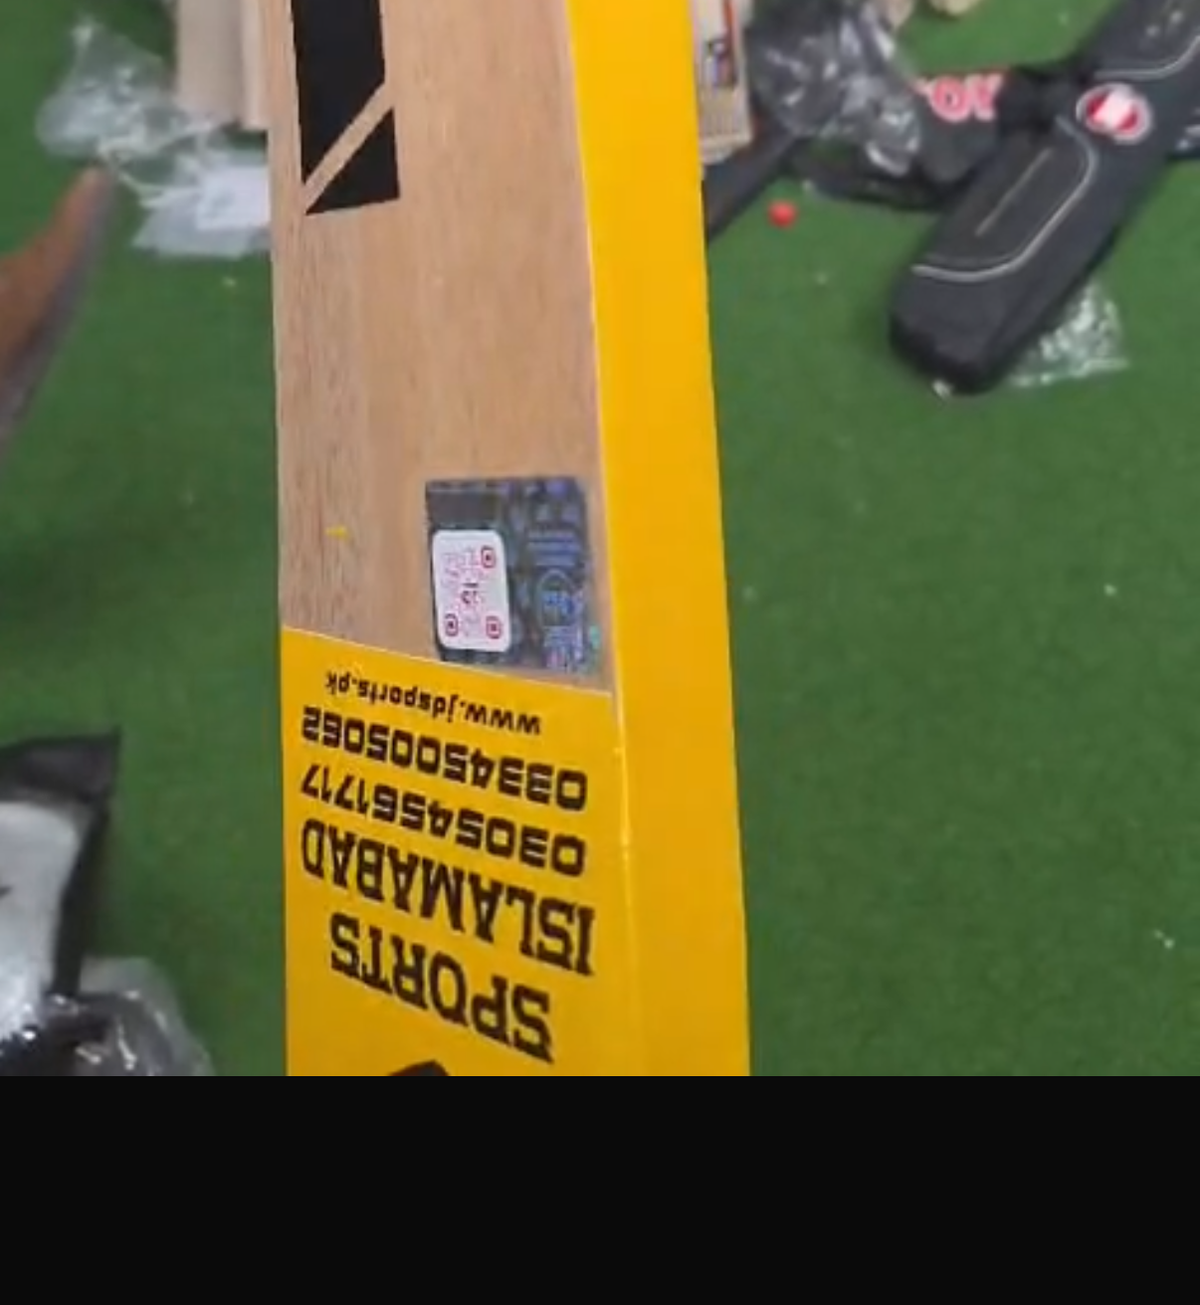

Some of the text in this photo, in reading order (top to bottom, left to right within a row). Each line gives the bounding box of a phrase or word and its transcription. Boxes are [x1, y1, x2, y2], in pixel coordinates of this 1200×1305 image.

[302, 705, 588, 812] 03345005062
[325, 670, 542, 736] www.jdsports.pk
[300, 763, 586, 878] 03054561717
[300, 818, 596, 977] ISLAMABAD
[330, 911, 555, 1065] SPORTS
